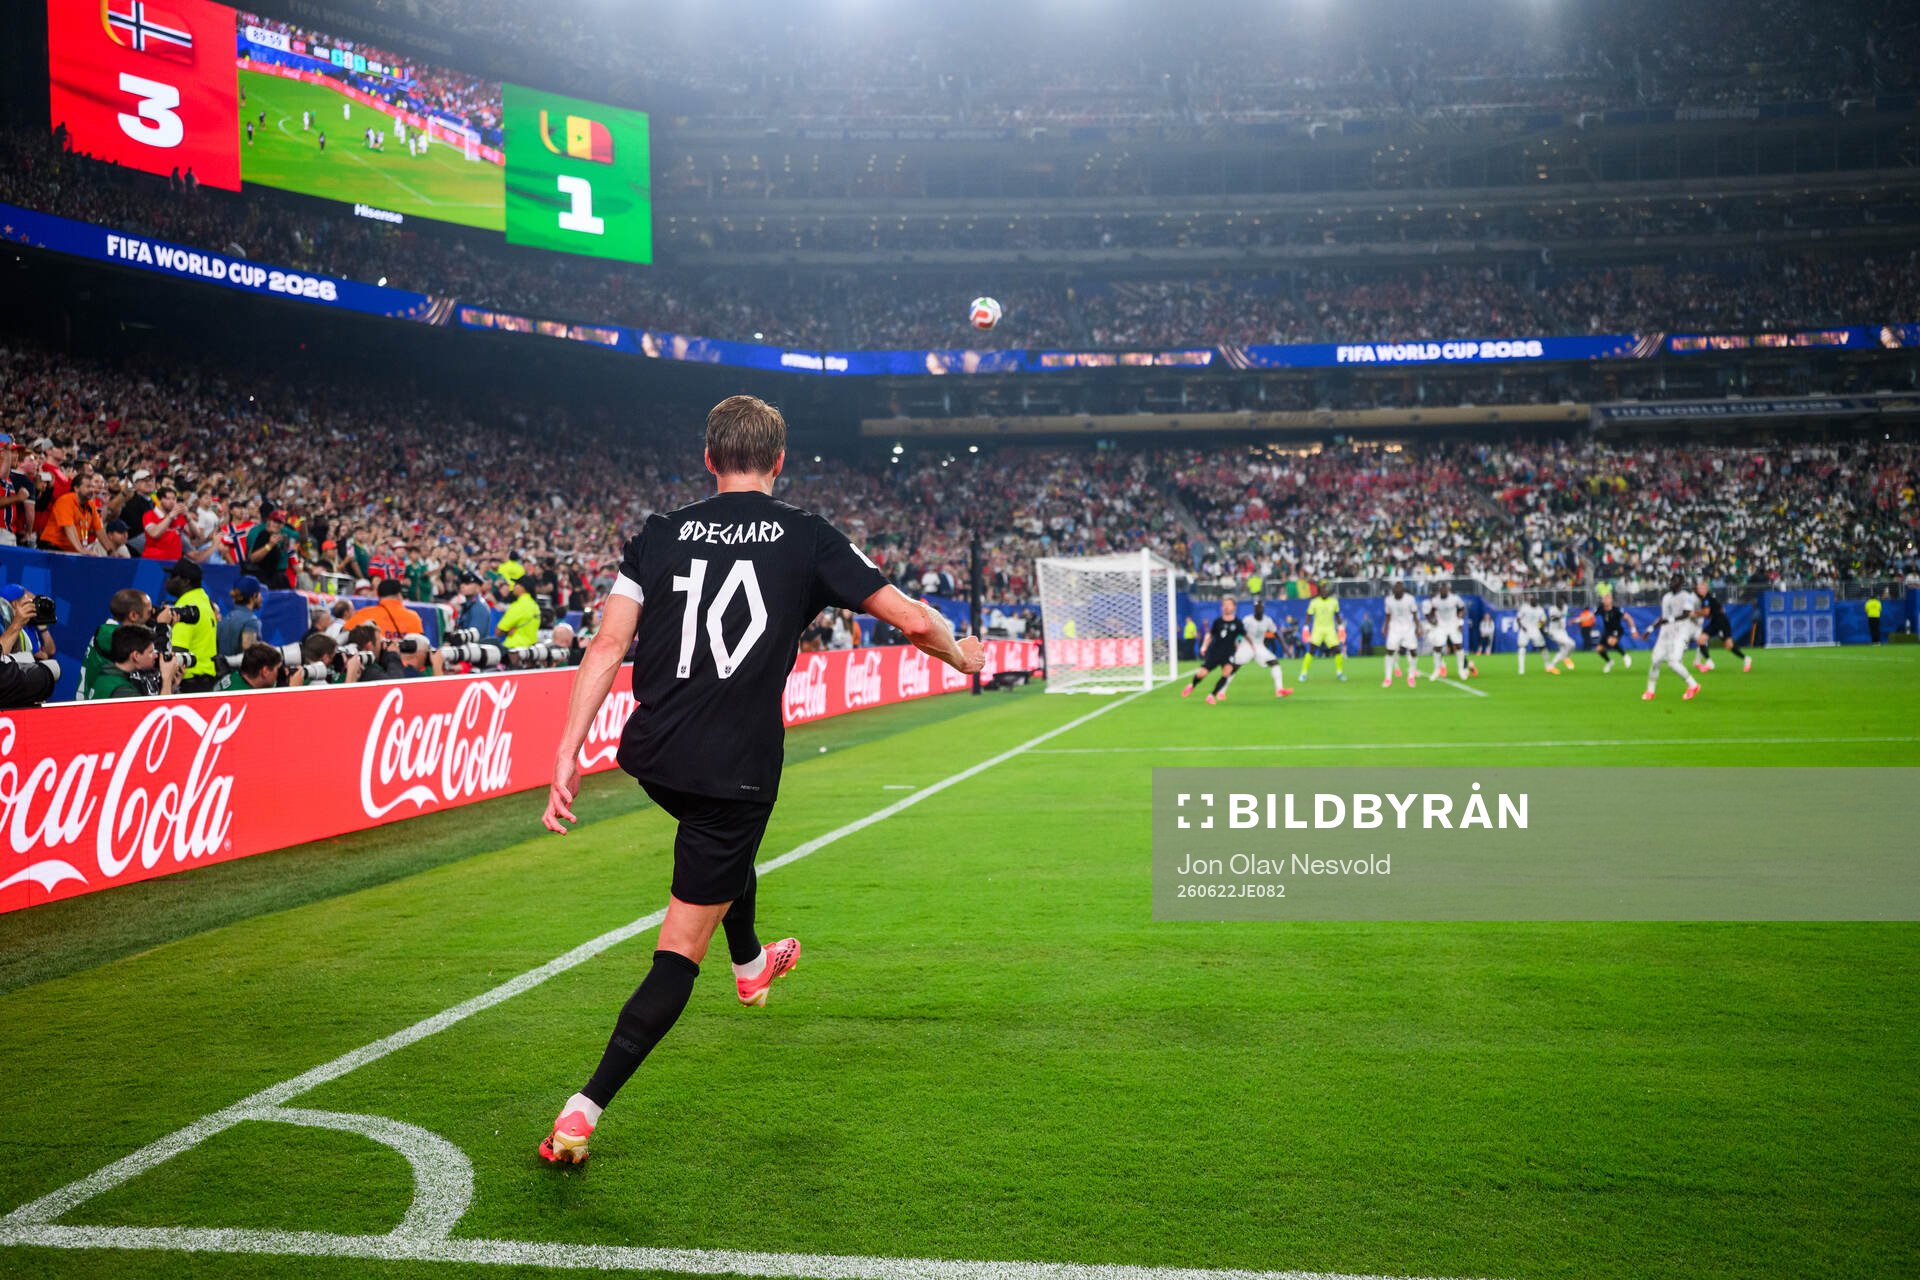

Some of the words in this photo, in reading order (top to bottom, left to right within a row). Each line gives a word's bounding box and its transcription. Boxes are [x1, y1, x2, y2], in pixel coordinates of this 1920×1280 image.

[117, 72, 185, 149] 3
[354, 203, 404, 225] Hisense
[557, 174, 605, 236] 1
[106, 234, 153, 265] FIFA
[154, 244, 227, 280] WORLD
[228, 262, 267, 288] CUP
[268, 271, 338, 301] 2026
[1336, 345, 1376, 363] FIFA
[1376, 343, 1441, 361] WORLD
[1442, 342, 1479, 359] CUP
[1479, 340, 1543, 358] 2026
[678, 520, 785, 545] ØDEGAARD
[672, 558, 768, 679] 10
[361, 680, 518, 819] Coca-Cola
[0, 703, 248, 893] ca-Cola
